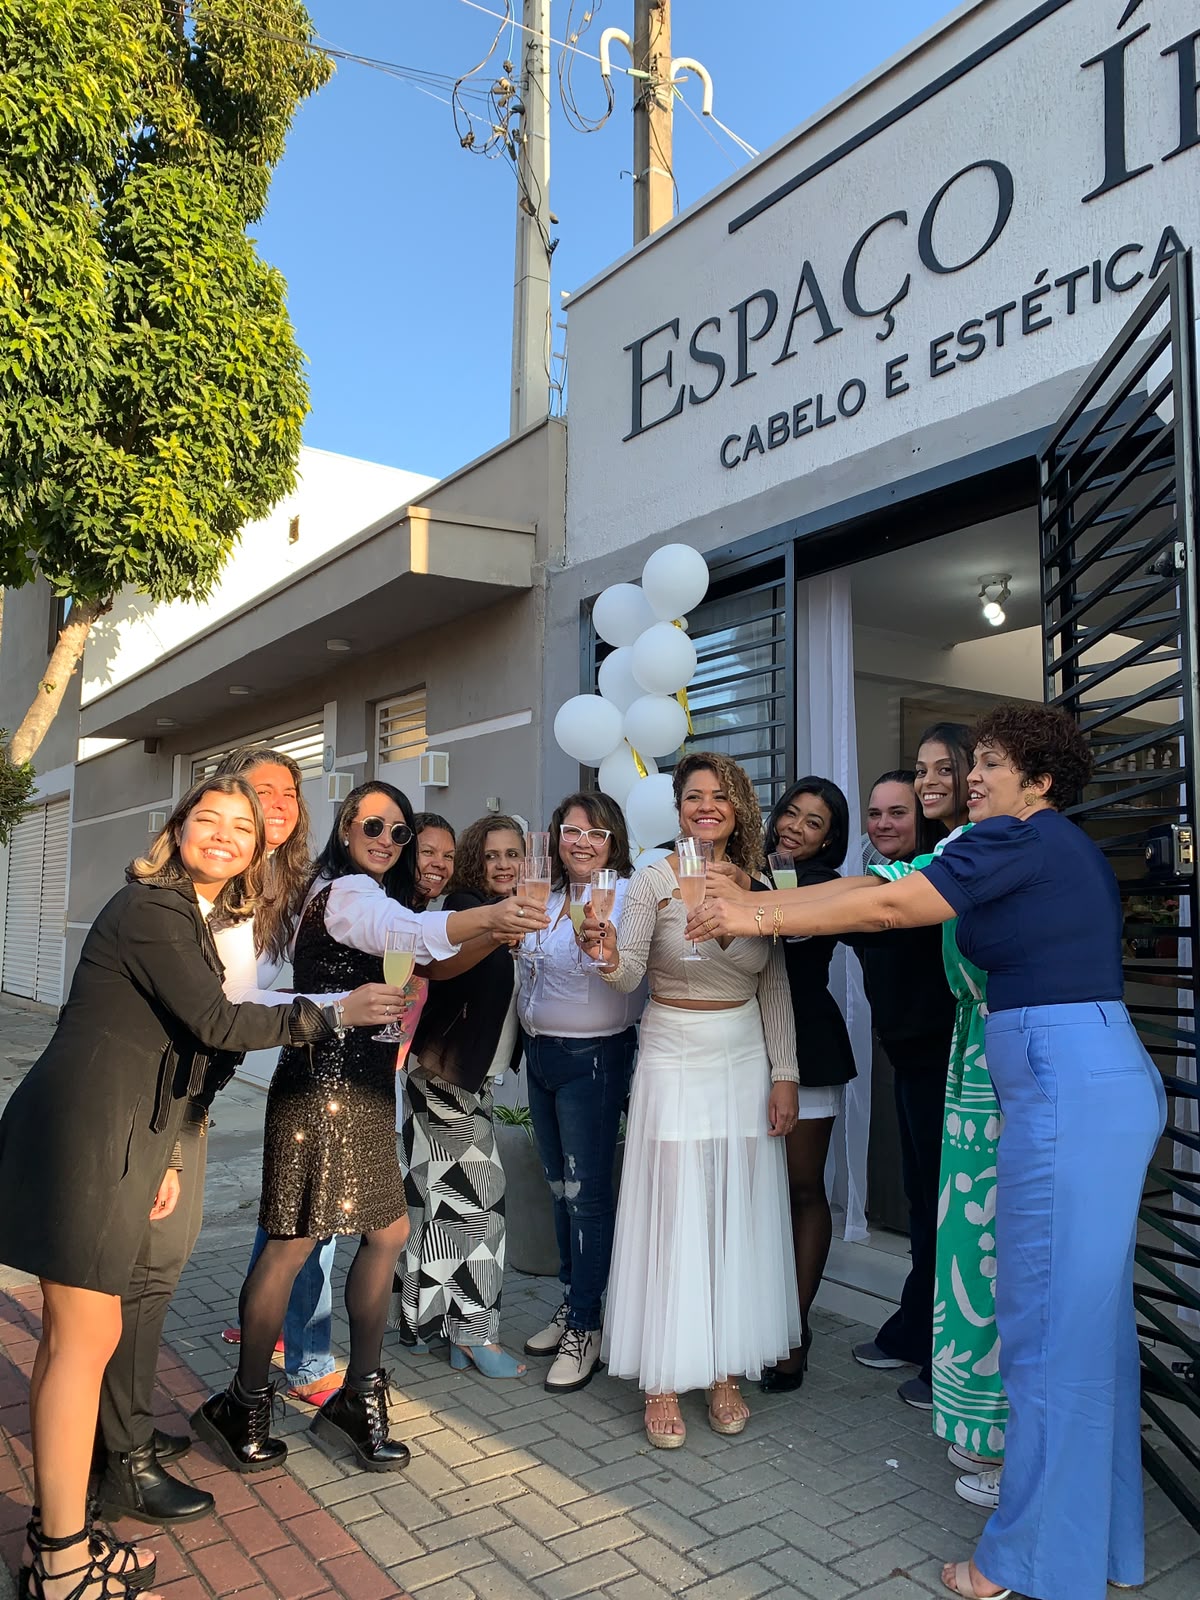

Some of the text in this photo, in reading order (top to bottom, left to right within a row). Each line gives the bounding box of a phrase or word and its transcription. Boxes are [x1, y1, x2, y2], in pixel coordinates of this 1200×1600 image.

[622, 158, 1014, 443] ESPAÇO
[720, 225, 1185, 469] CABELO E ESTÉTICA
